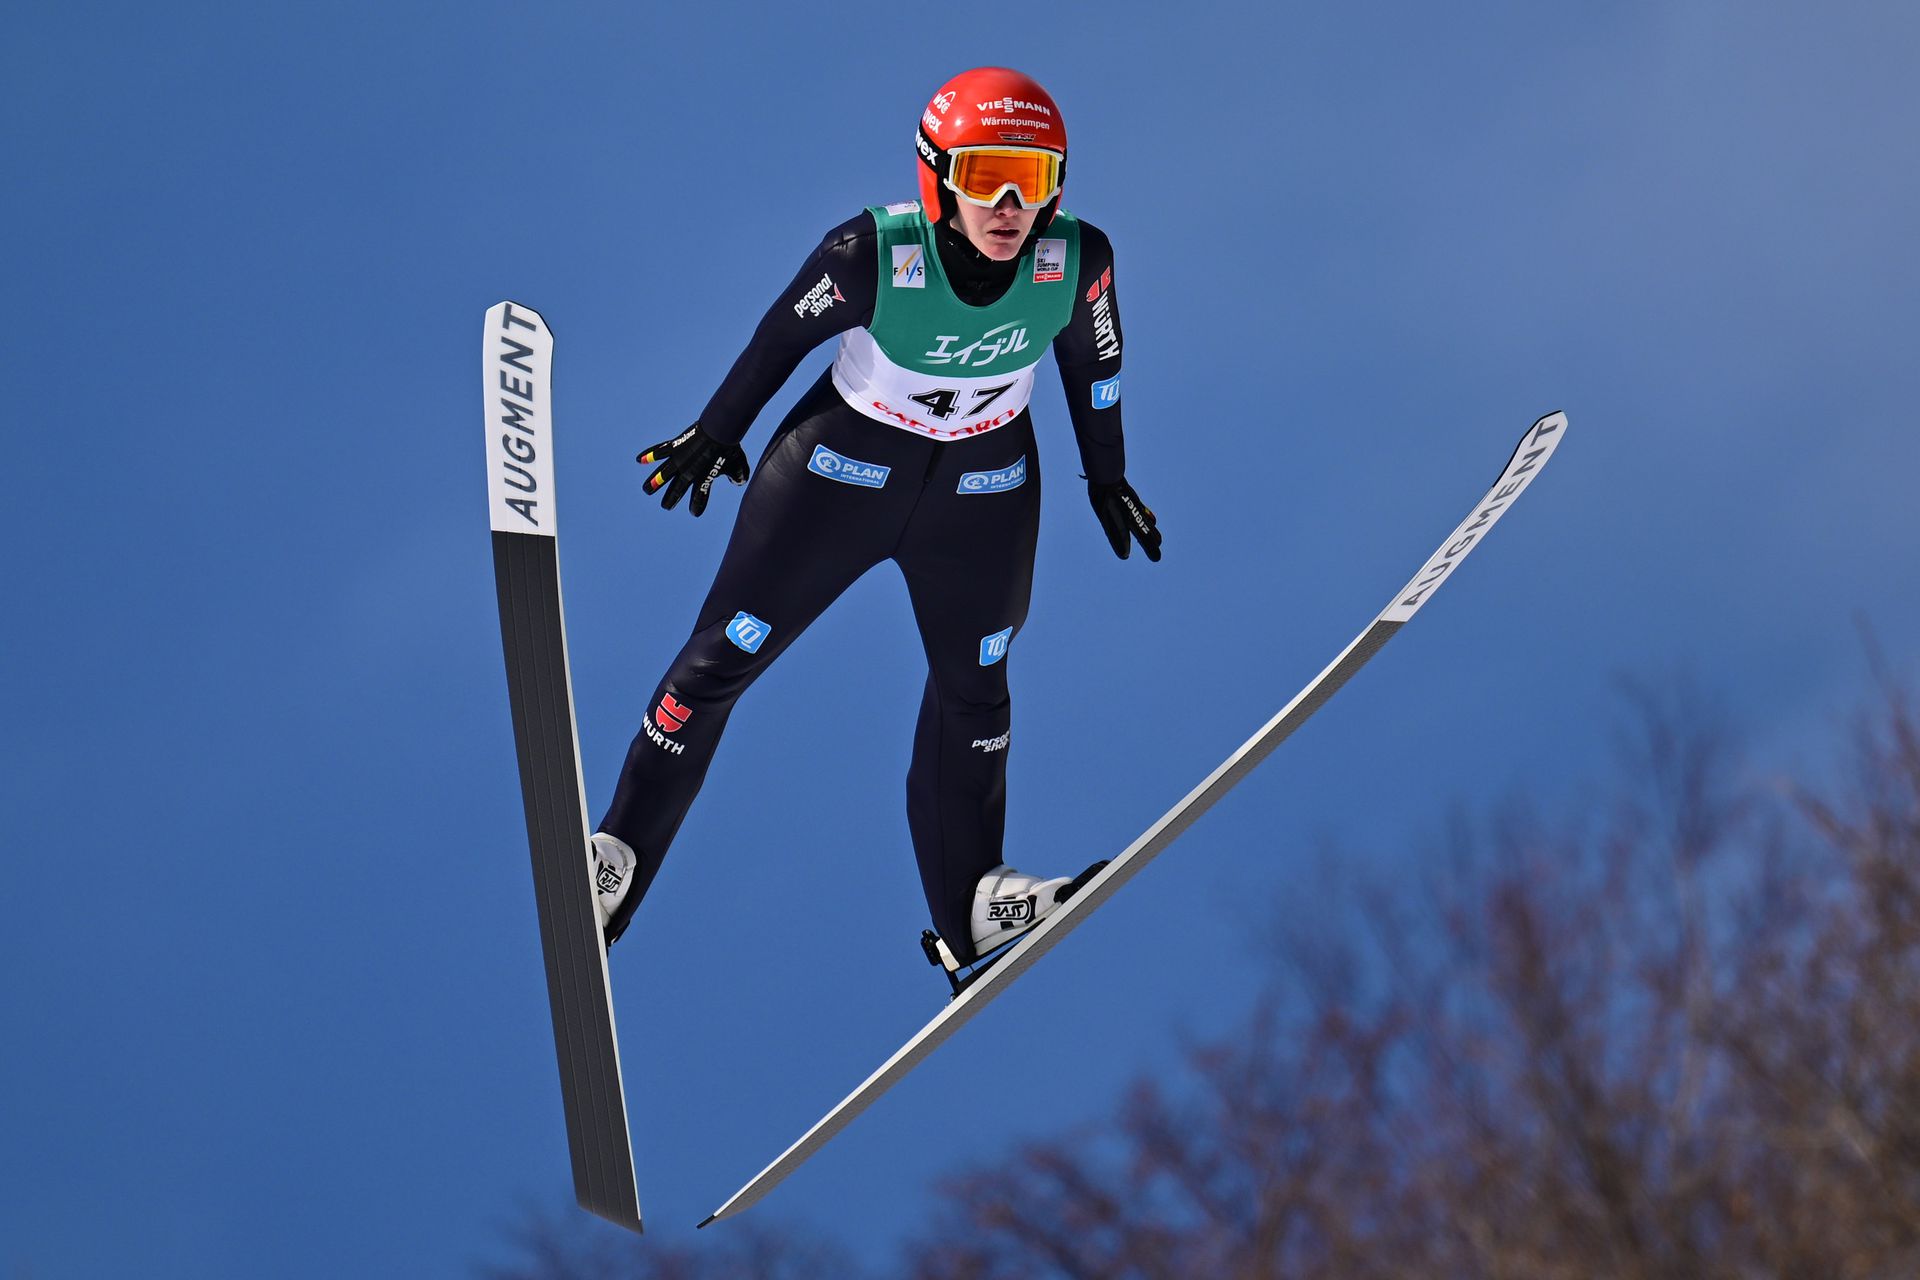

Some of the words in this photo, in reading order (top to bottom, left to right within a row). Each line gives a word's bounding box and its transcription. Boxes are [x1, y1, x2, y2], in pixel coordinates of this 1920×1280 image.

[977, 97, 1050, 116] VIESSMANN
[981, 117, 1050, 130] Wärmepumpen
[794, 273, 833, 318] personal
[810, 293, 834, 317] shop
[925, 328, 1030, 367] エイブル
[500, 303, 537, 527] AUGMENT
[907, 379, 1018, 421] 47
[700, 456, 726, 495] ziener
[842, 463, 884, 480] PLAN
[991, 463, 1024, 484] PLAN
[1121, 495, 1150, 534] ziener
[1401, 422, 1558, 606] AUGMENT
[989, 904, 1025, 918] RAST
